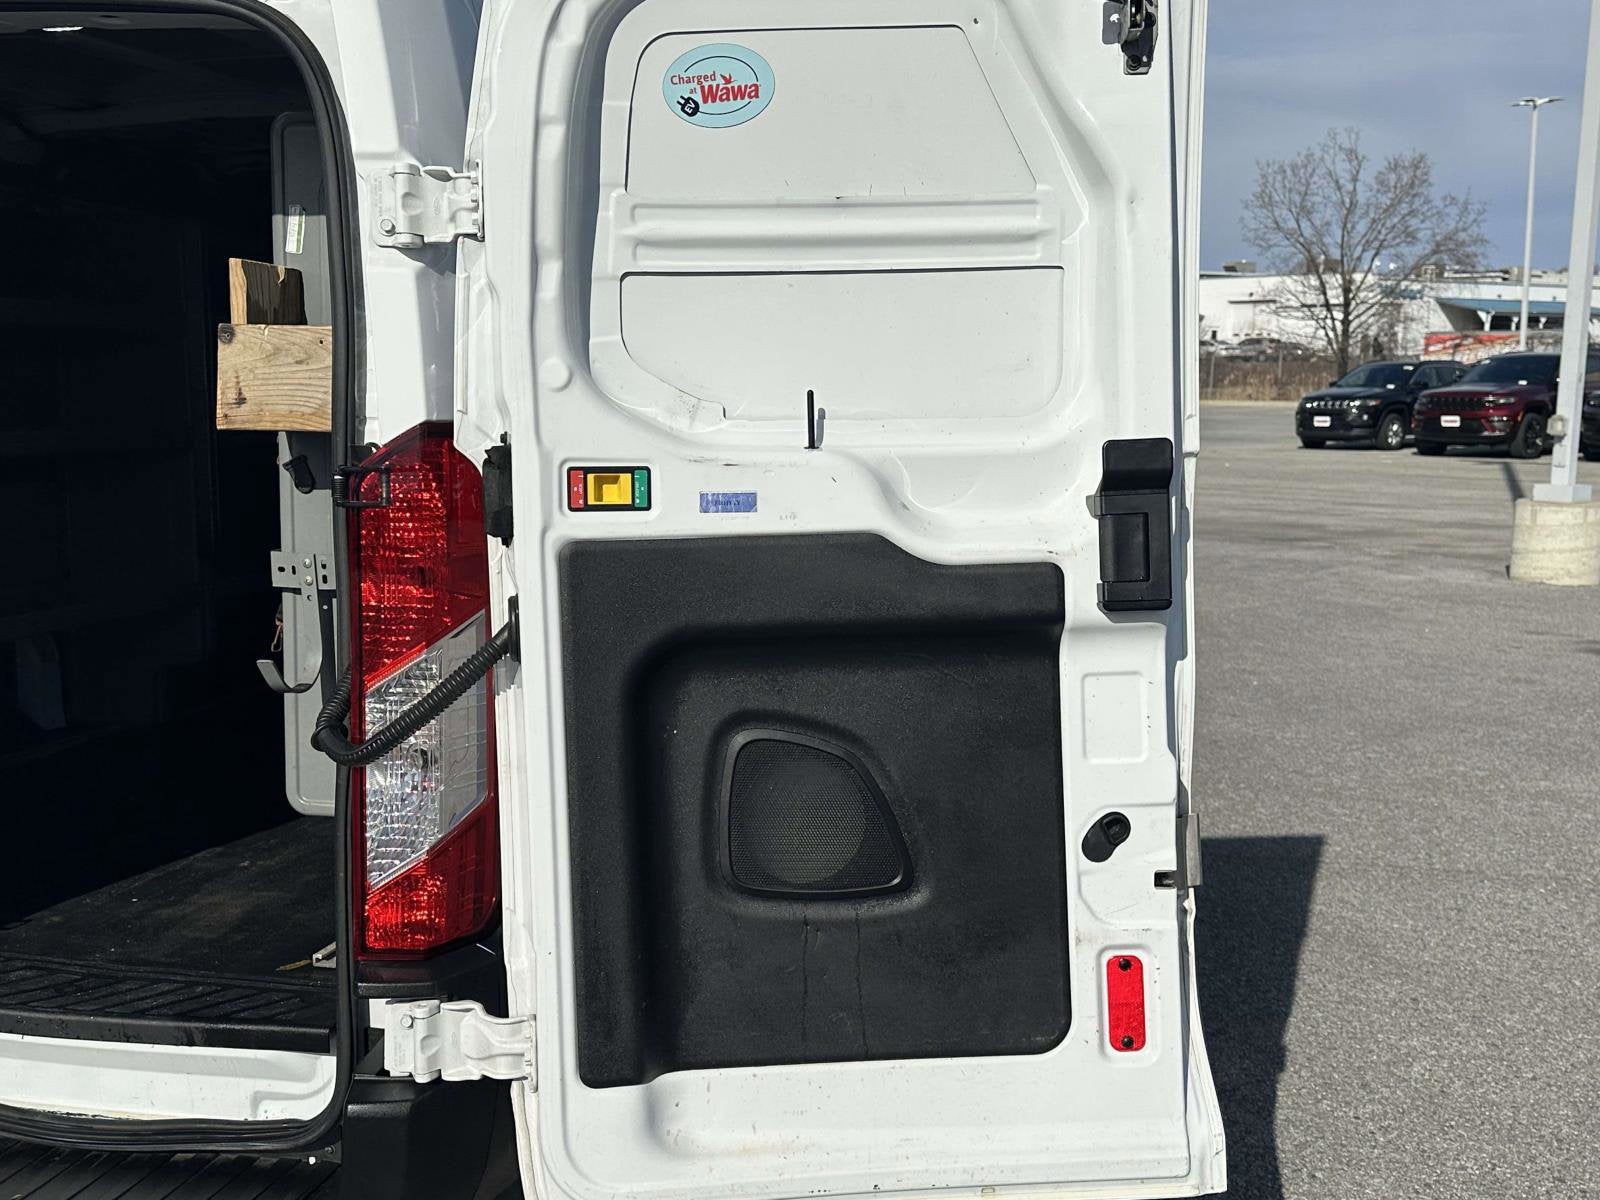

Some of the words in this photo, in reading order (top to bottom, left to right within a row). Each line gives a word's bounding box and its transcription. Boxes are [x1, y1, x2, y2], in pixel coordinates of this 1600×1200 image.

[670, 70, 717, 86] Charged
[689, 87, 697, 95] at
[700, 83, 760, 104] Wawa
[684, 100, 696, 114] EV
